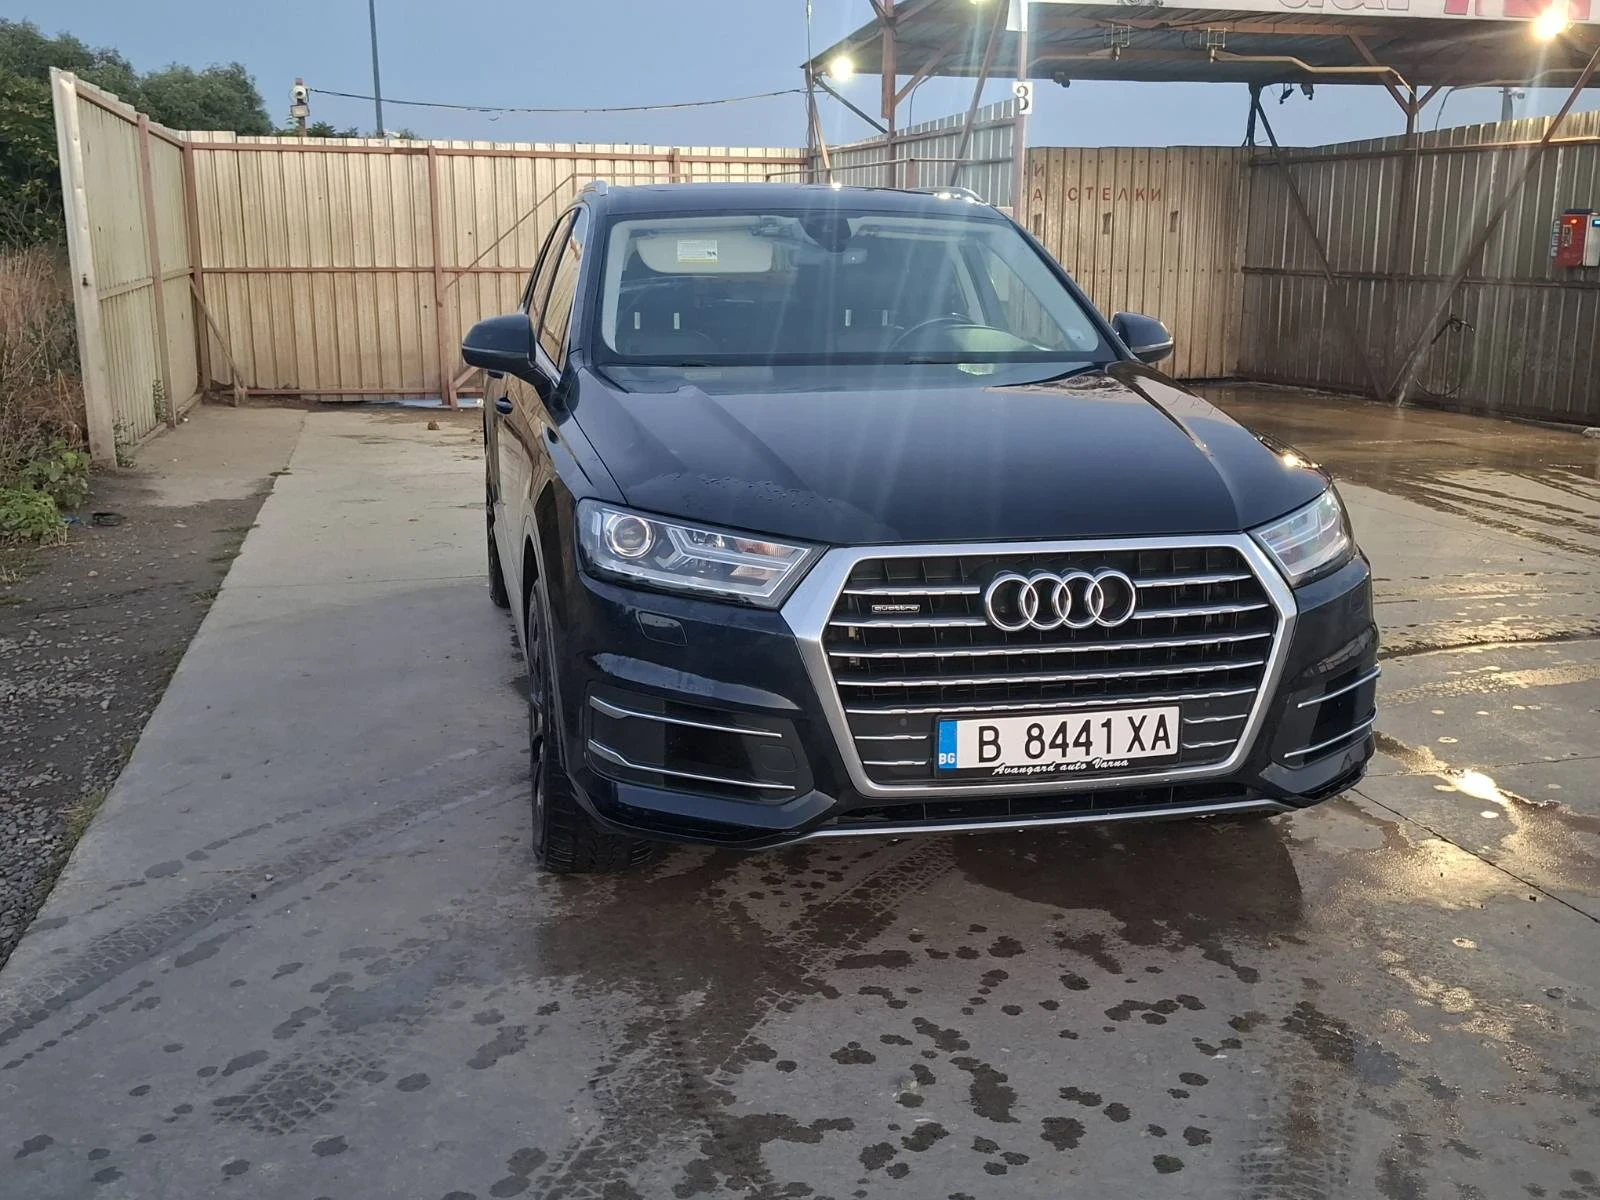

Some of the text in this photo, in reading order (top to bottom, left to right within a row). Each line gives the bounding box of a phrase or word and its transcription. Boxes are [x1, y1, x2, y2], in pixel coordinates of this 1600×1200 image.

[1016, 85, 1029, 110] 3
[1067, 187, 1161, 202] СТЕЛКИ
[978, 713, 1172, 763] B 8441 XA
[938, 752, 956, 765] BG
[992, 757, 1129, 776] Avangard auto Varna
